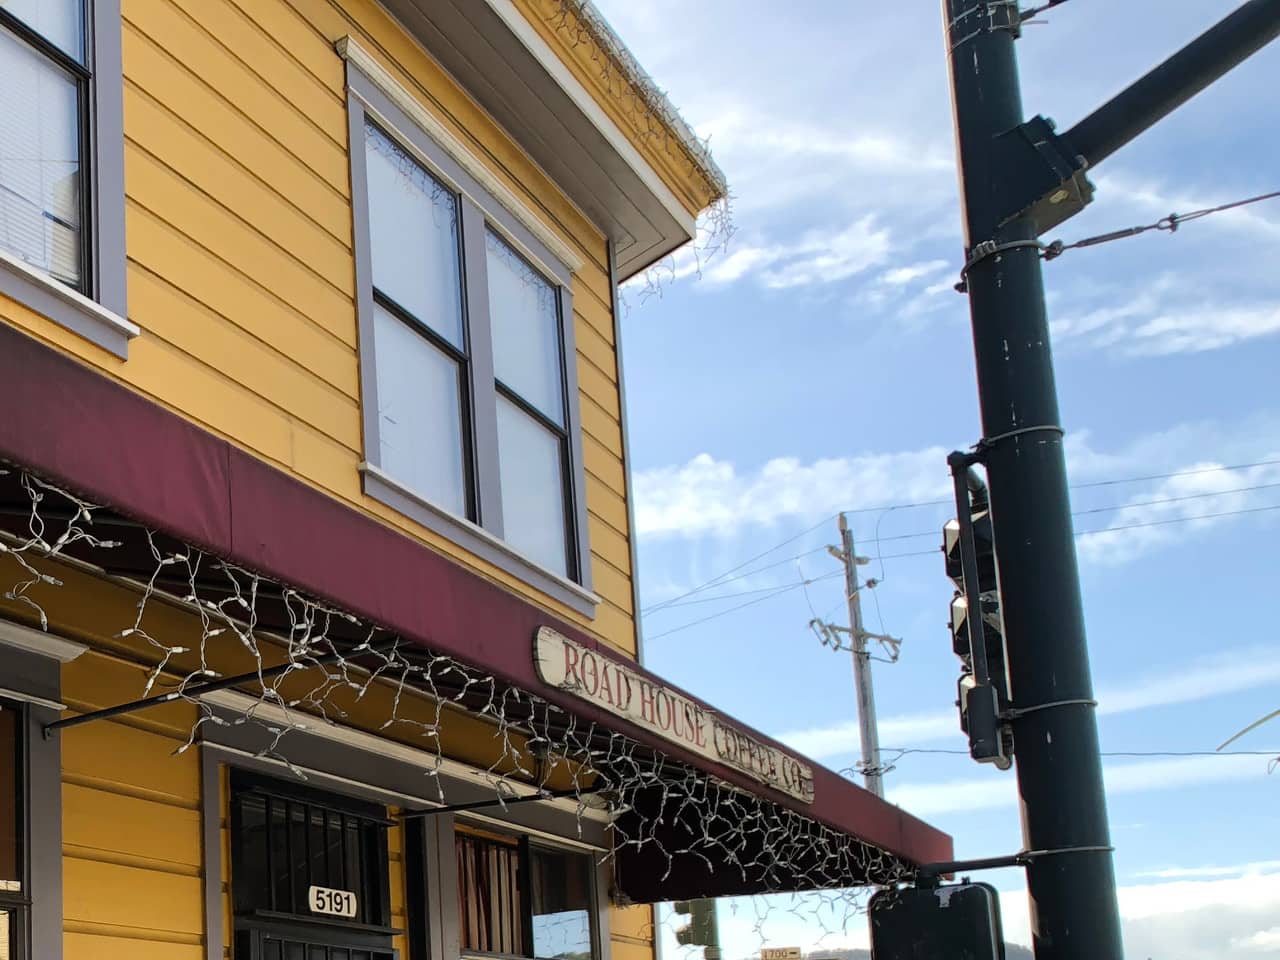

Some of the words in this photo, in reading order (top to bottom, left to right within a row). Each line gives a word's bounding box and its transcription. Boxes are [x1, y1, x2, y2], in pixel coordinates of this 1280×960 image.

[562, 641, 632, 711] ROAD
[640, 680, 707, 749] HOUSE
[712, 718, 776, 779] COFFEE
[315, 889, 351, 914] 5191
